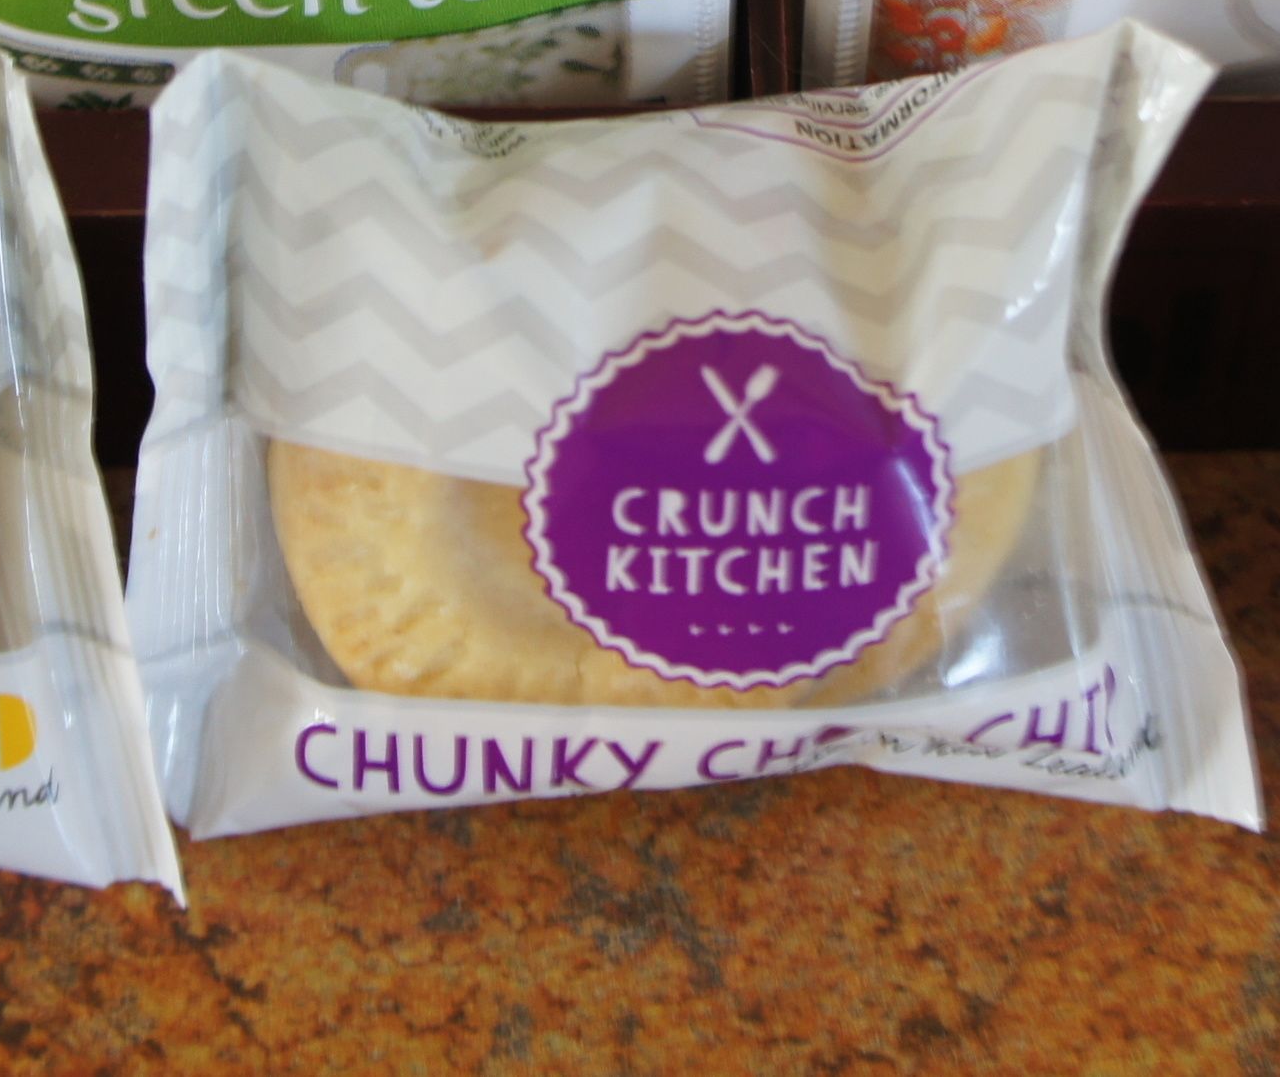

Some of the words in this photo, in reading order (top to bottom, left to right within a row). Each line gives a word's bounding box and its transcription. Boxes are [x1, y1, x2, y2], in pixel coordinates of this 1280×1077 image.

[612, 486, 870, 537] CRUNCH
[605, 540, 878, 595] KITCHEN
[294, 723, 664, 795] CHUNKY
